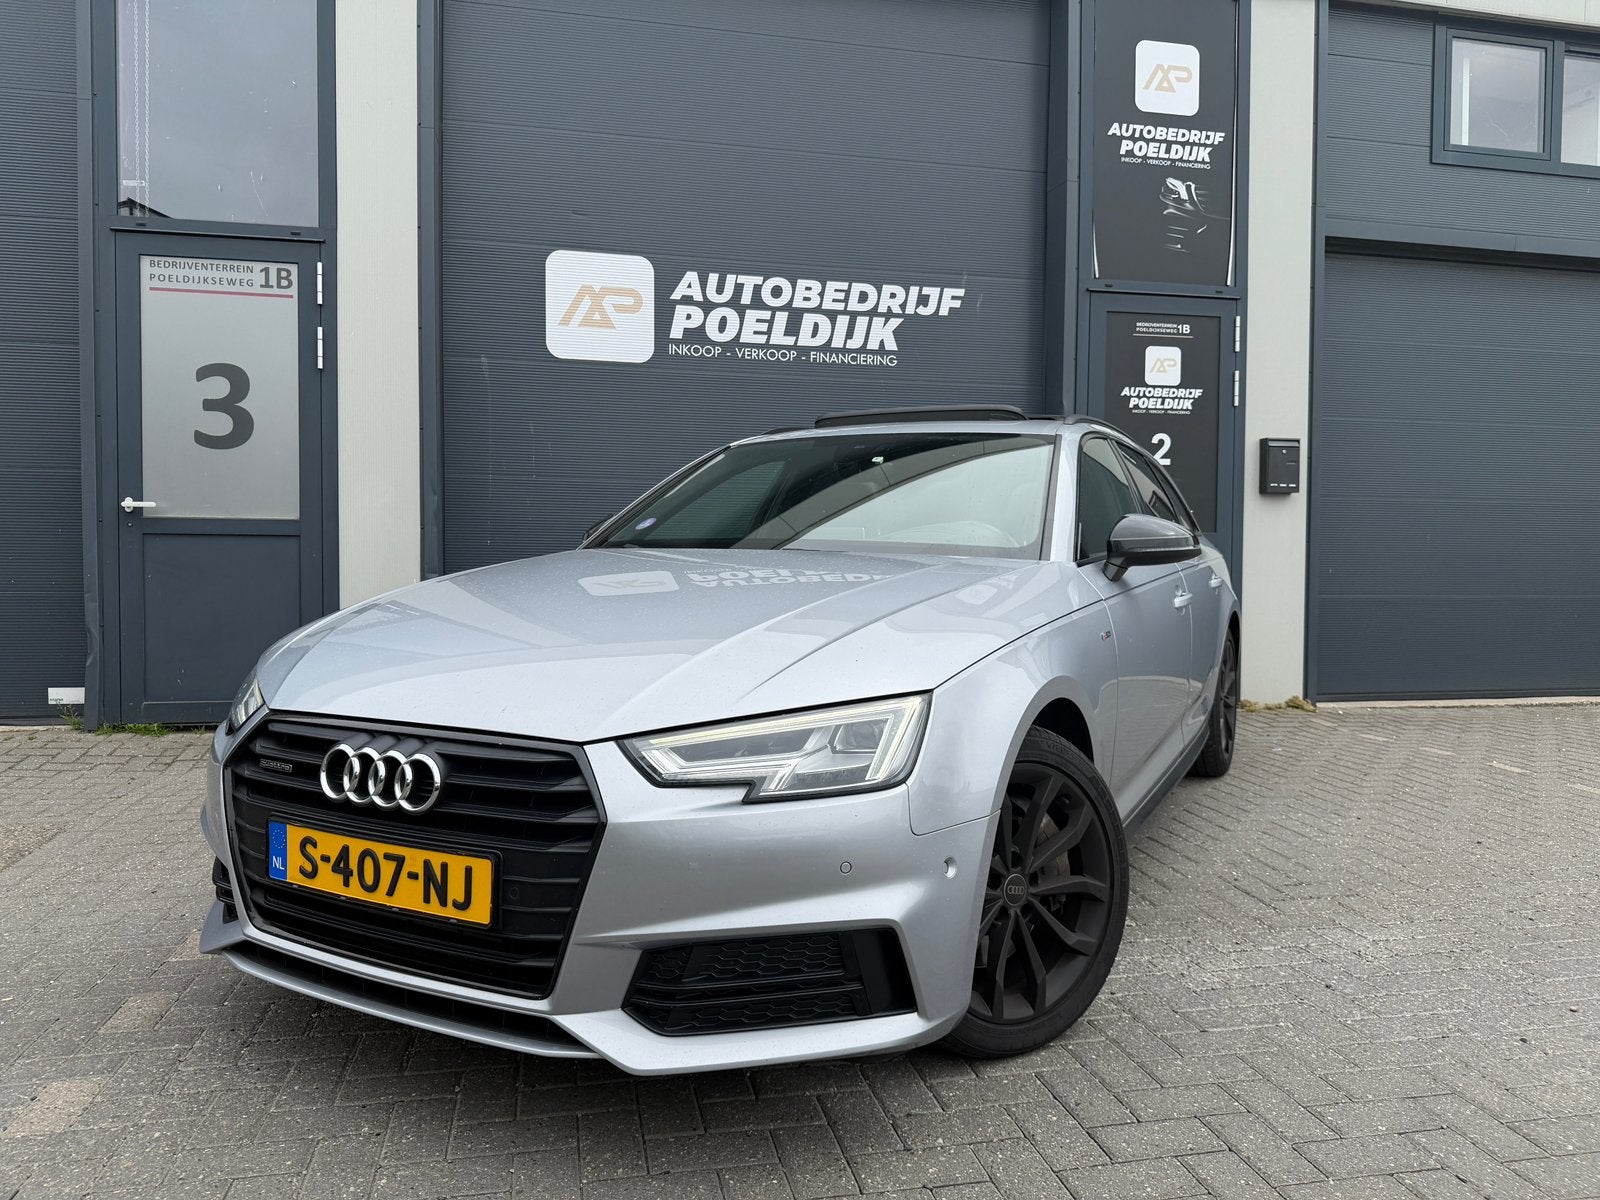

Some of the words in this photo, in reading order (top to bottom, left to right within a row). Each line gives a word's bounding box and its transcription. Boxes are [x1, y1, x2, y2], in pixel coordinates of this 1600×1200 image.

[1107, 122, 1226, 145] AUTOBEDRIJF
[1119, 139, 1213, 162] POELDIJK
[149, 259, 254, 274] BEDRIJVENTERREIN
[259, 266, 294, 290] 1B
[149, 273, 254, 287] POELDIJKSEWEG
[669, 271, 965, 316] AUTOBEDRIJF
[669, 305, 904, 351] POELDIJK
[1177, 324, 1191, 334] 1B
[668, 343, 722, 358] INKOOP
[735, 347, 797, 362] VERKOOP
[810, 351, 898, 366] FINANCIERING
[1121, 386, 1203, 398] AUTOBEDRIJF
[1129, 397, 1195, 410] POELDIJK
[194, 363, 254, 450] 3
[1151, 433, 1172, 465] 2
[272, 856, 285, 870] NL
[299, 835, 473, 912] S-407-NJ
